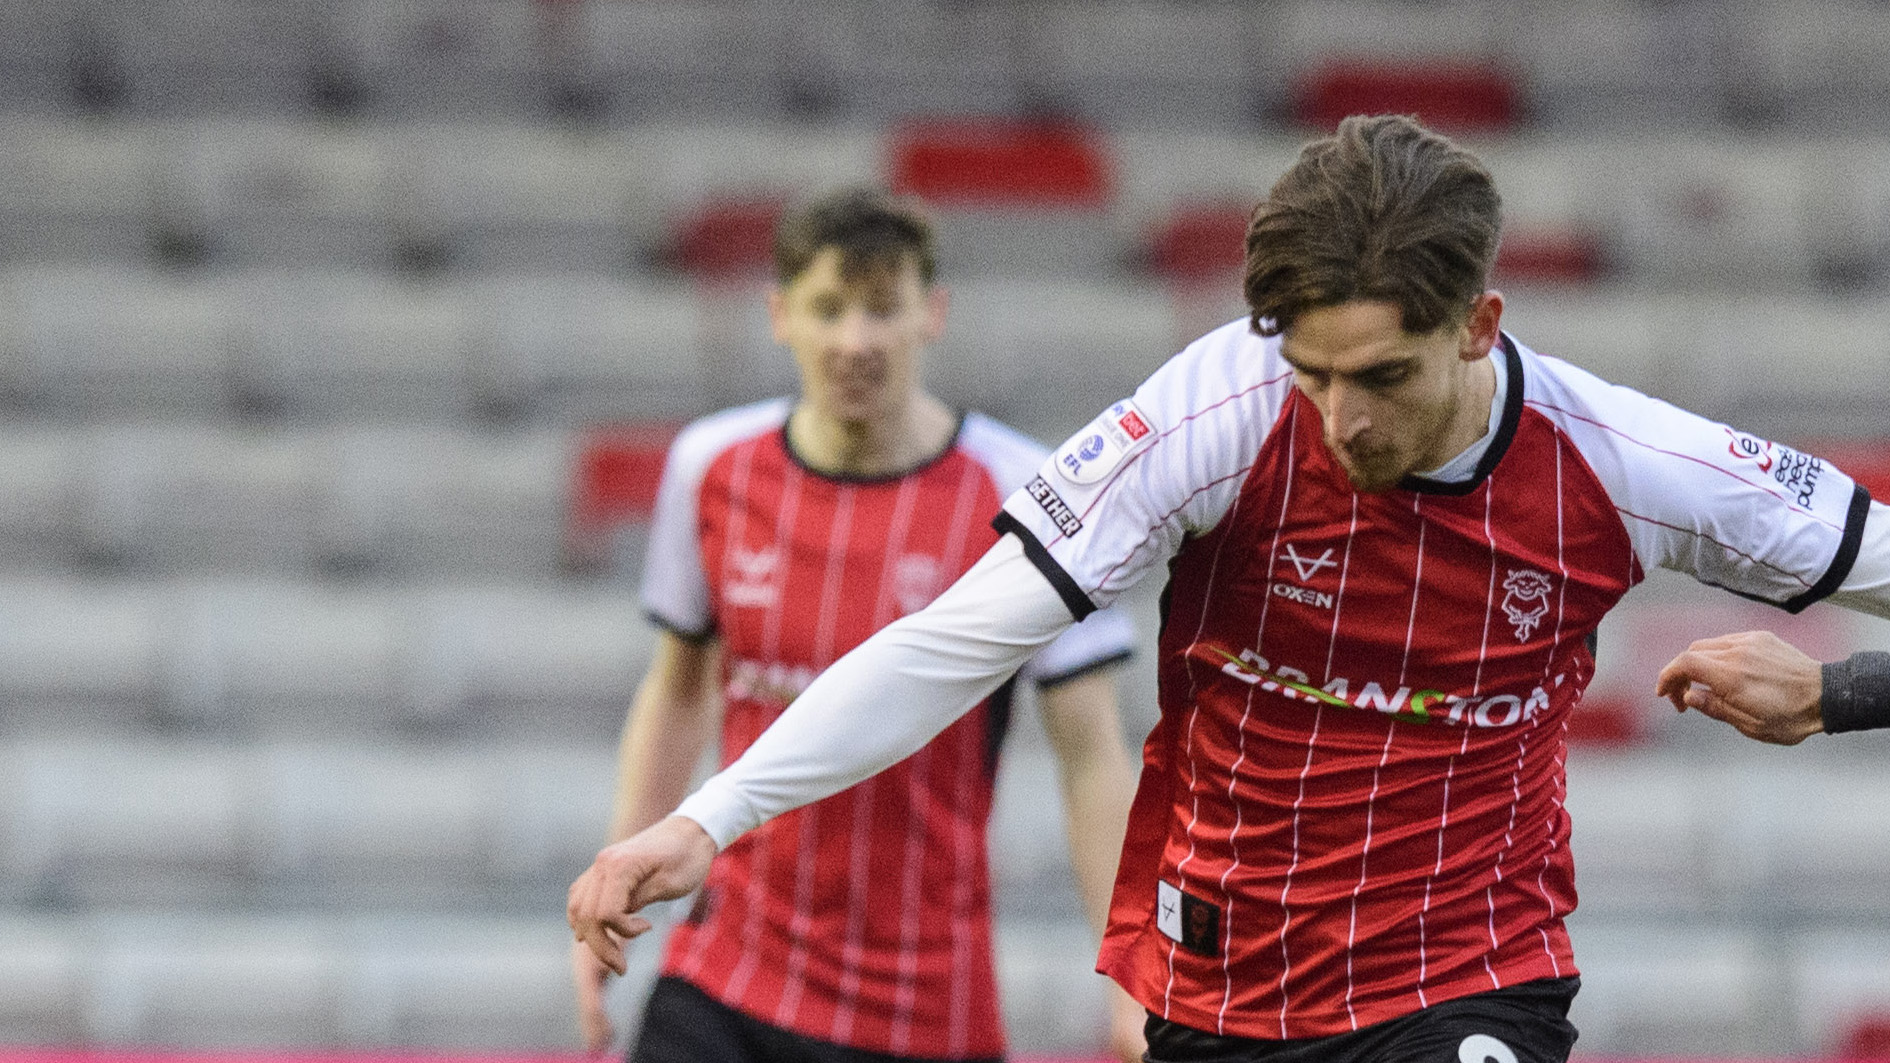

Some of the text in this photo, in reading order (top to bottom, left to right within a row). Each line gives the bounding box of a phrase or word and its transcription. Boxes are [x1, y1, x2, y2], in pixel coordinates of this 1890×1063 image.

[1063, 453, 1082, 476] EFL
[1797, 456, 1825, 511] pump
[1026, 477, 1081, 537] GETHER
[1273, 583, 1333, 609] OXEN
